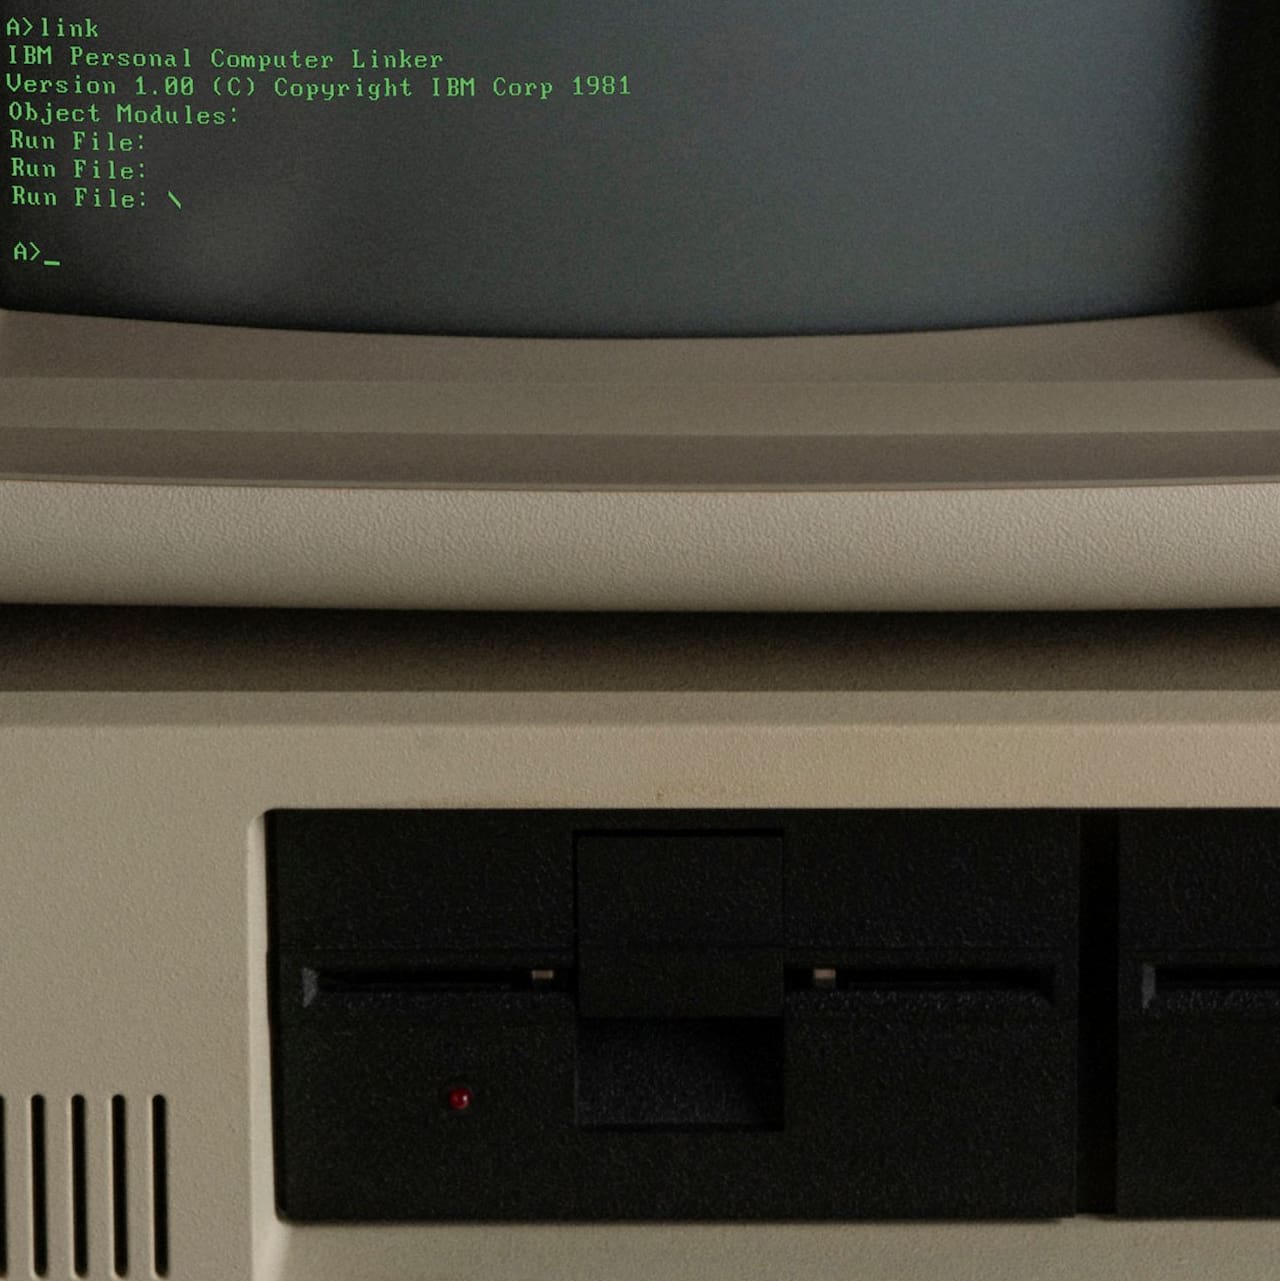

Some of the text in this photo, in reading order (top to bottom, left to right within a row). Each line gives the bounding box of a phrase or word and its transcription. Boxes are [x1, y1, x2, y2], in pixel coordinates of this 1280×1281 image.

[5, 16, 99, 39] A>link
[9, 44, 443, 72] IBM Personal Computer Linker
[5, 73, 629, 101] Version 1.00 (C) Copyright IBM Corp 1981
[8, 100, 240, 125] Object Modules:
[10, 128, 148, 152] Run File:
[11, 156, 148, 180] Run File:
[12, 185, 57, 205] Run
[72, 186, 148, 208] File:
